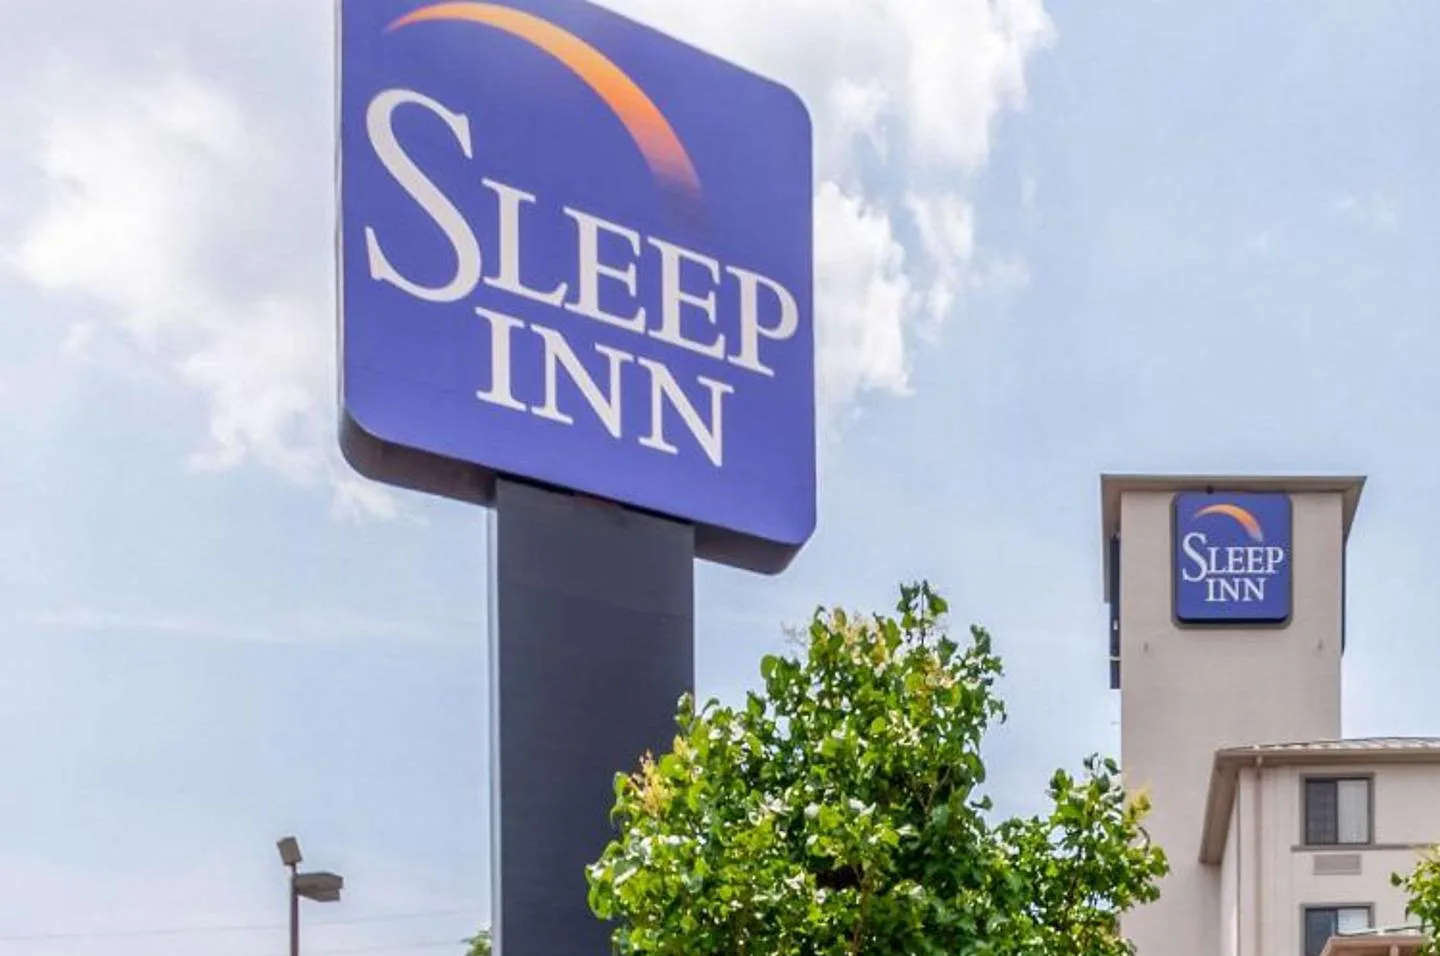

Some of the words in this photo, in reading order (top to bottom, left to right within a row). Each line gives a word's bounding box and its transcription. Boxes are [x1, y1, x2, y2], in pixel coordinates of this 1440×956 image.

[365, 89, 799, 377] SLEEP
[475, 306, 735, 467] INN
[1182, 532, 1284, 582] SLEEP
[1205, 577, 1267, 602] INN
